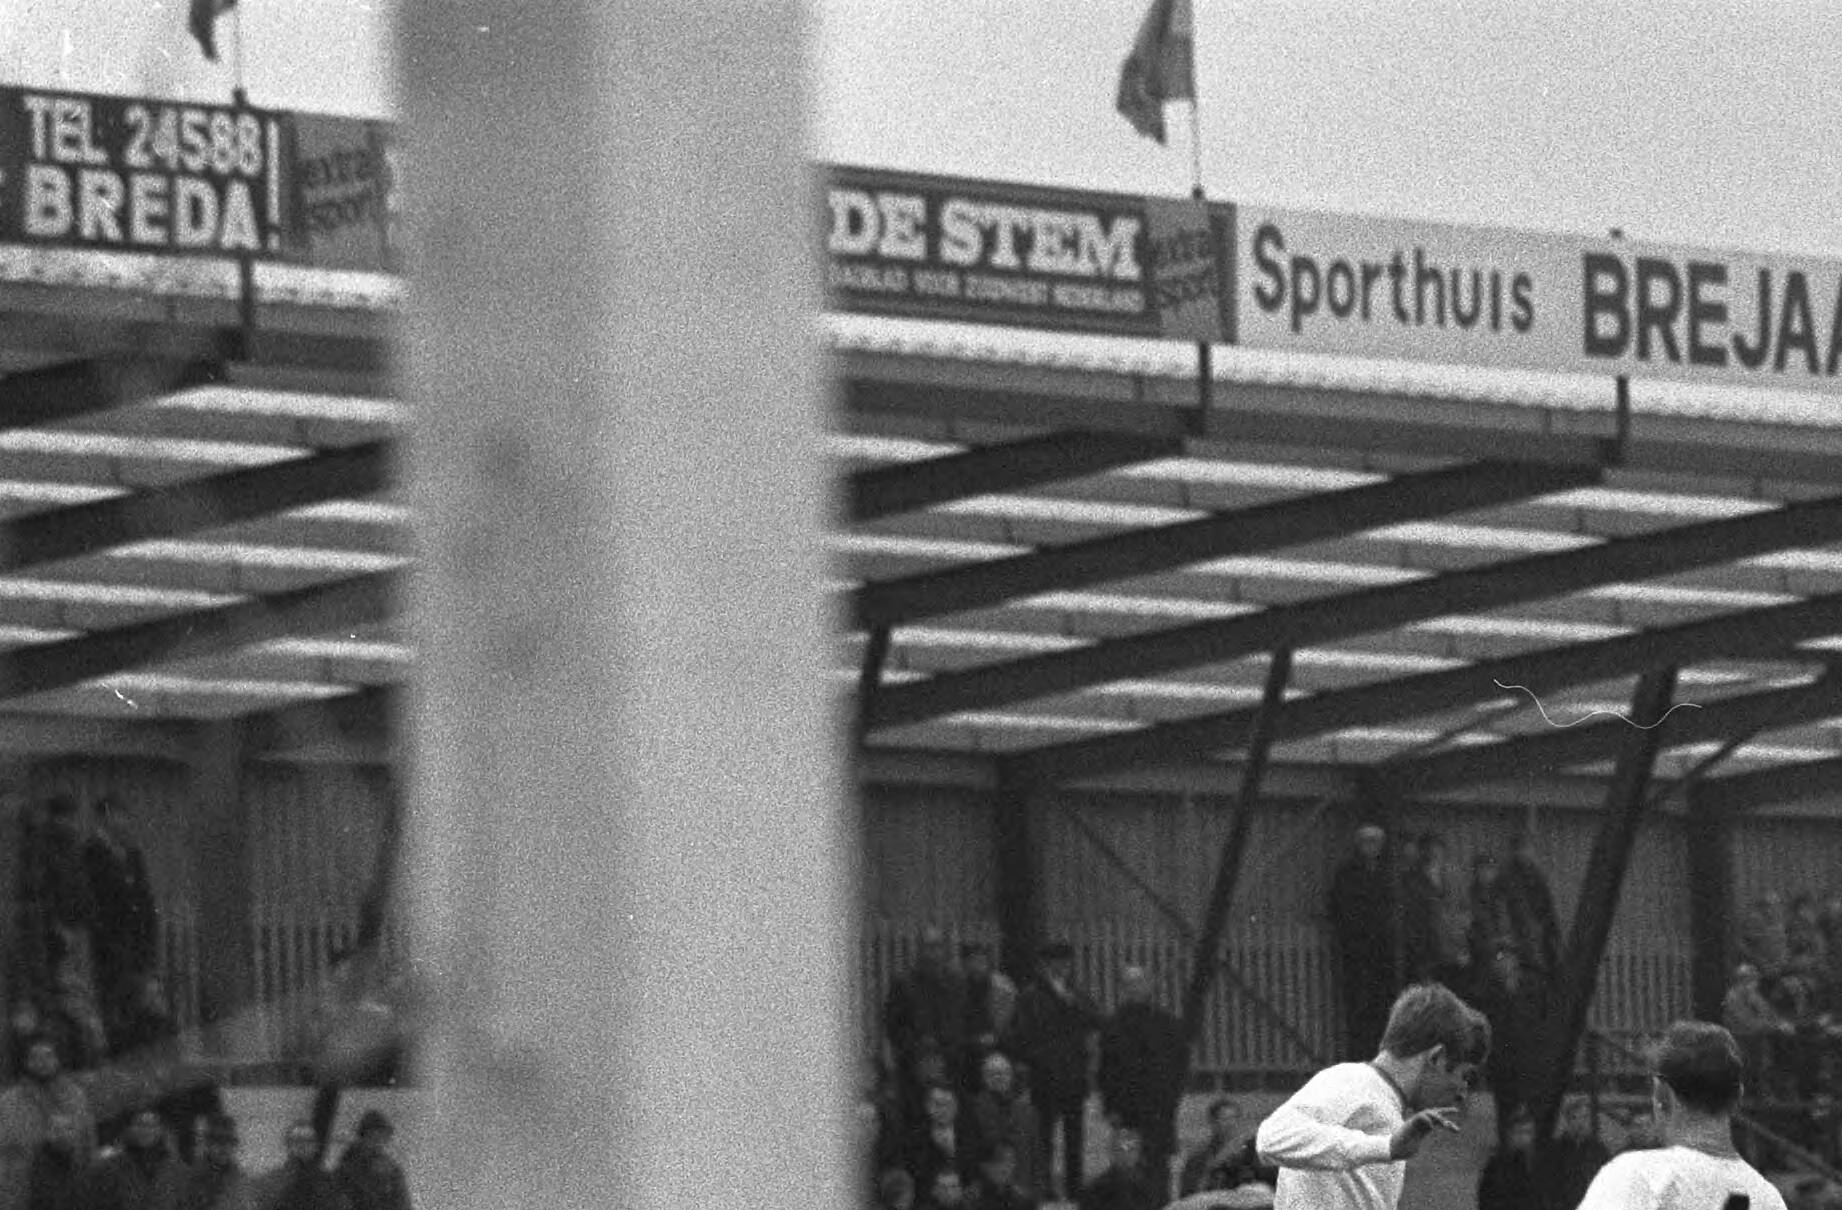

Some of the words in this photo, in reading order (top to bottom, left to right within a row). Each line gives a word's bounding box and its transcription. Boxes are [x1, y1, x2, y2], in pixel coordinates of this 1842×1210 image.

[24, 164, 262, 249] BREDA
[828, 189, 927, 260] DE
[940, 199, 1143, 289] STEM
[1252, 222, 1535, 334] Sporthuis
